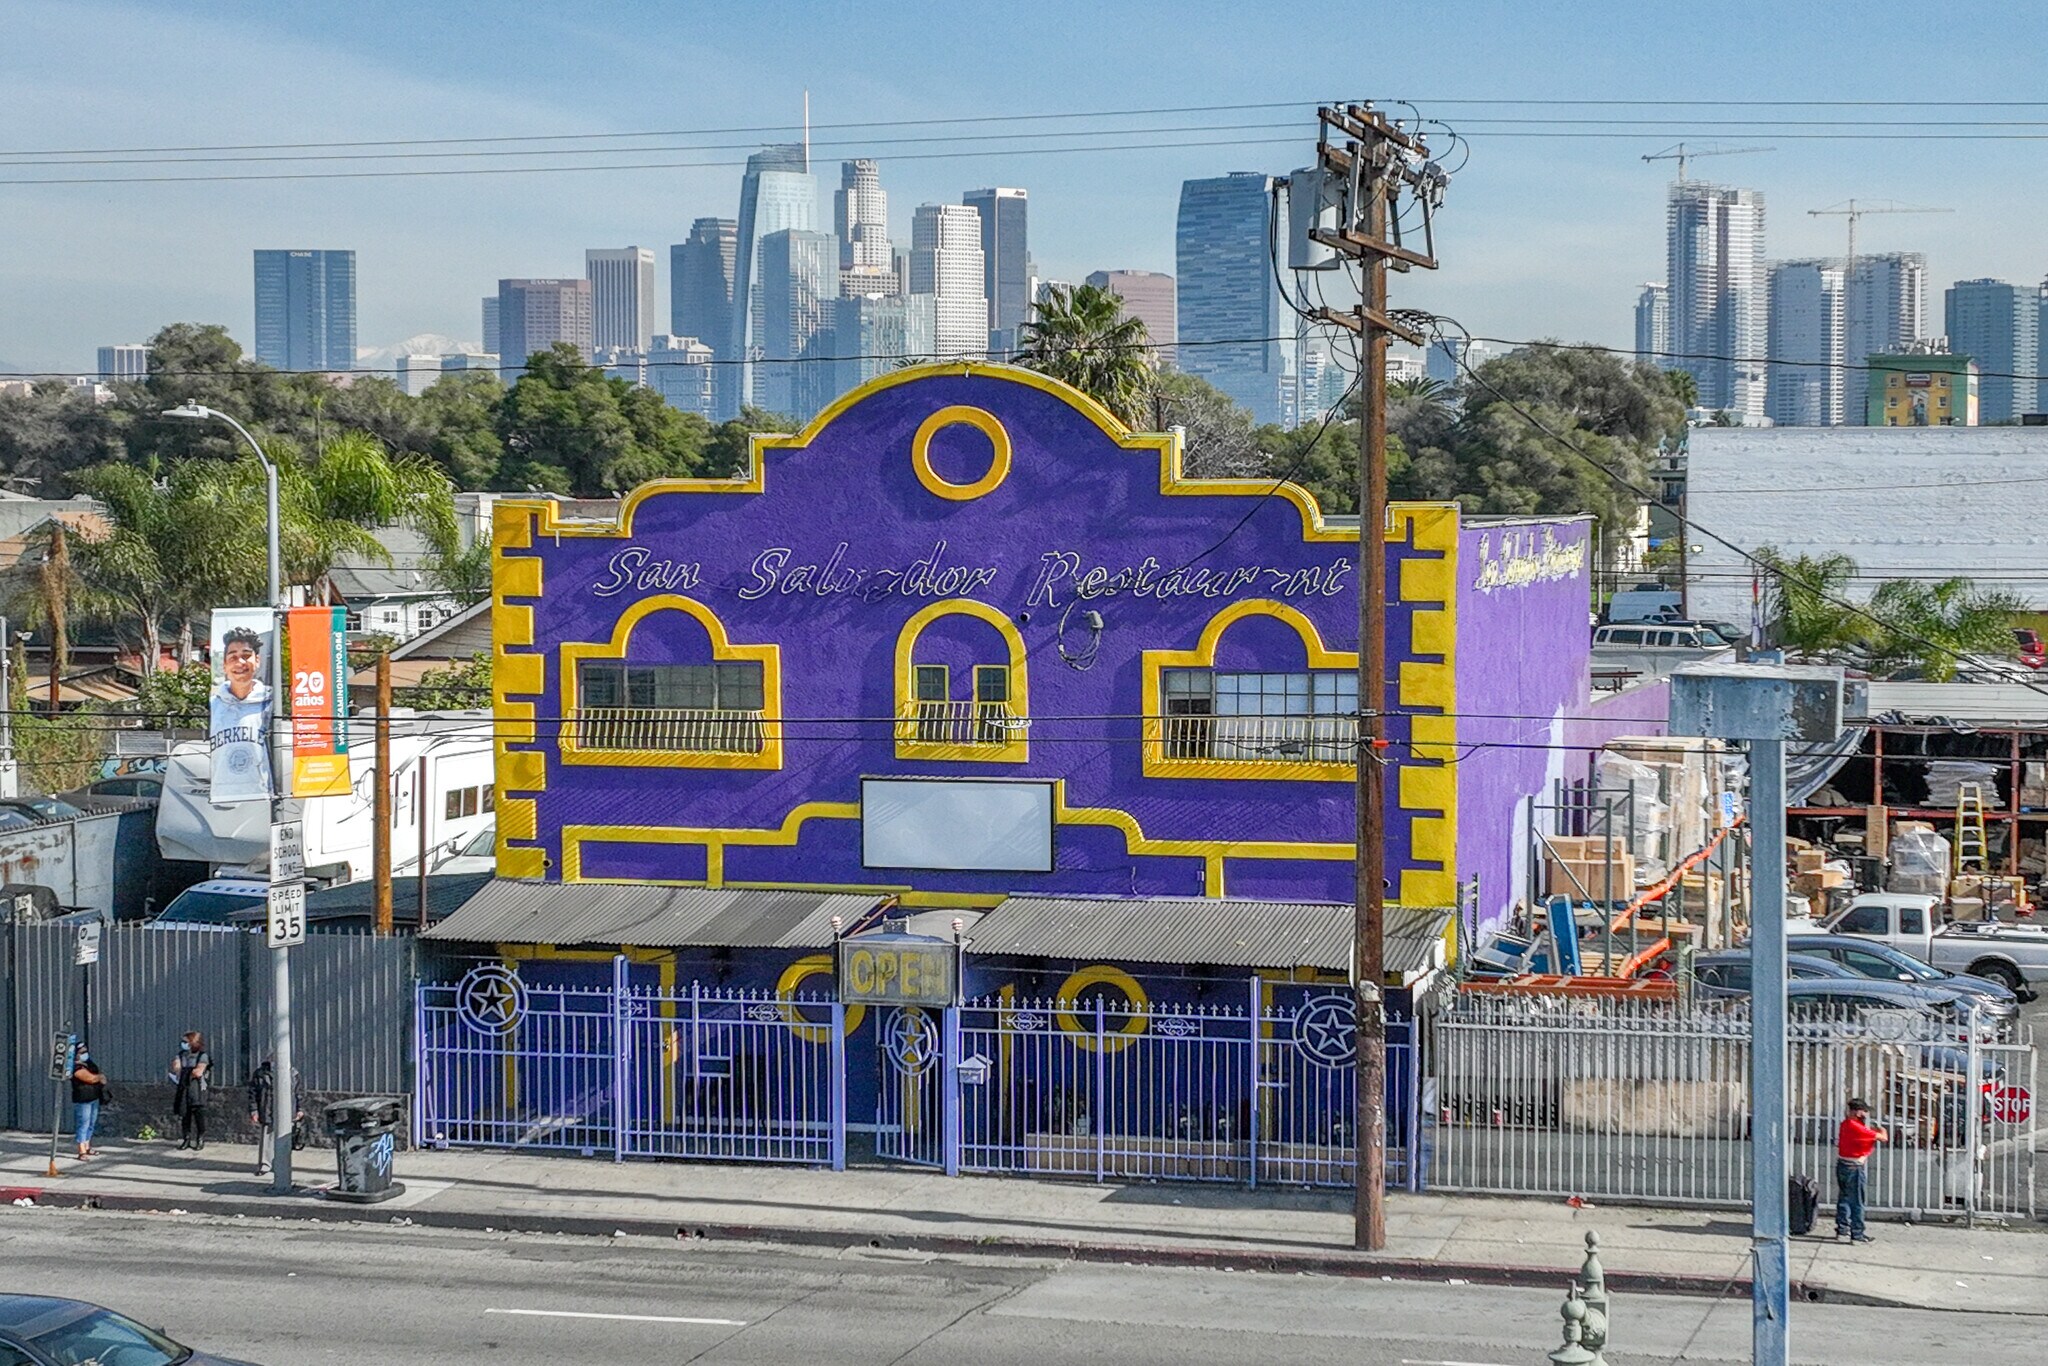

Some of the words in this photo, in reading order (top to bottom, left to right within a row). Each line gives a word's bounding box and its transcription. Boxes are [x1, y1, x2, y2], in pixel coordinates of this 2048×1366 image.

[594, 547, 700, 596] San
[295, 671, 324, 694] 20
[335, 632, 345, 746] WWWCAMINONUEVO.ORG
[295, 694, 324, 707] años
[280, 827, 294, 841] END
[274, 844, 301, 860] SCHOOL
[279, 861, 297, 877] ZONE
[272, 888, 302, 902] SPEED
[276, 902, 300, 915] LIMIT
[274, 917, 301, 941] 35
[850, 949, 947, 996] OPEN
